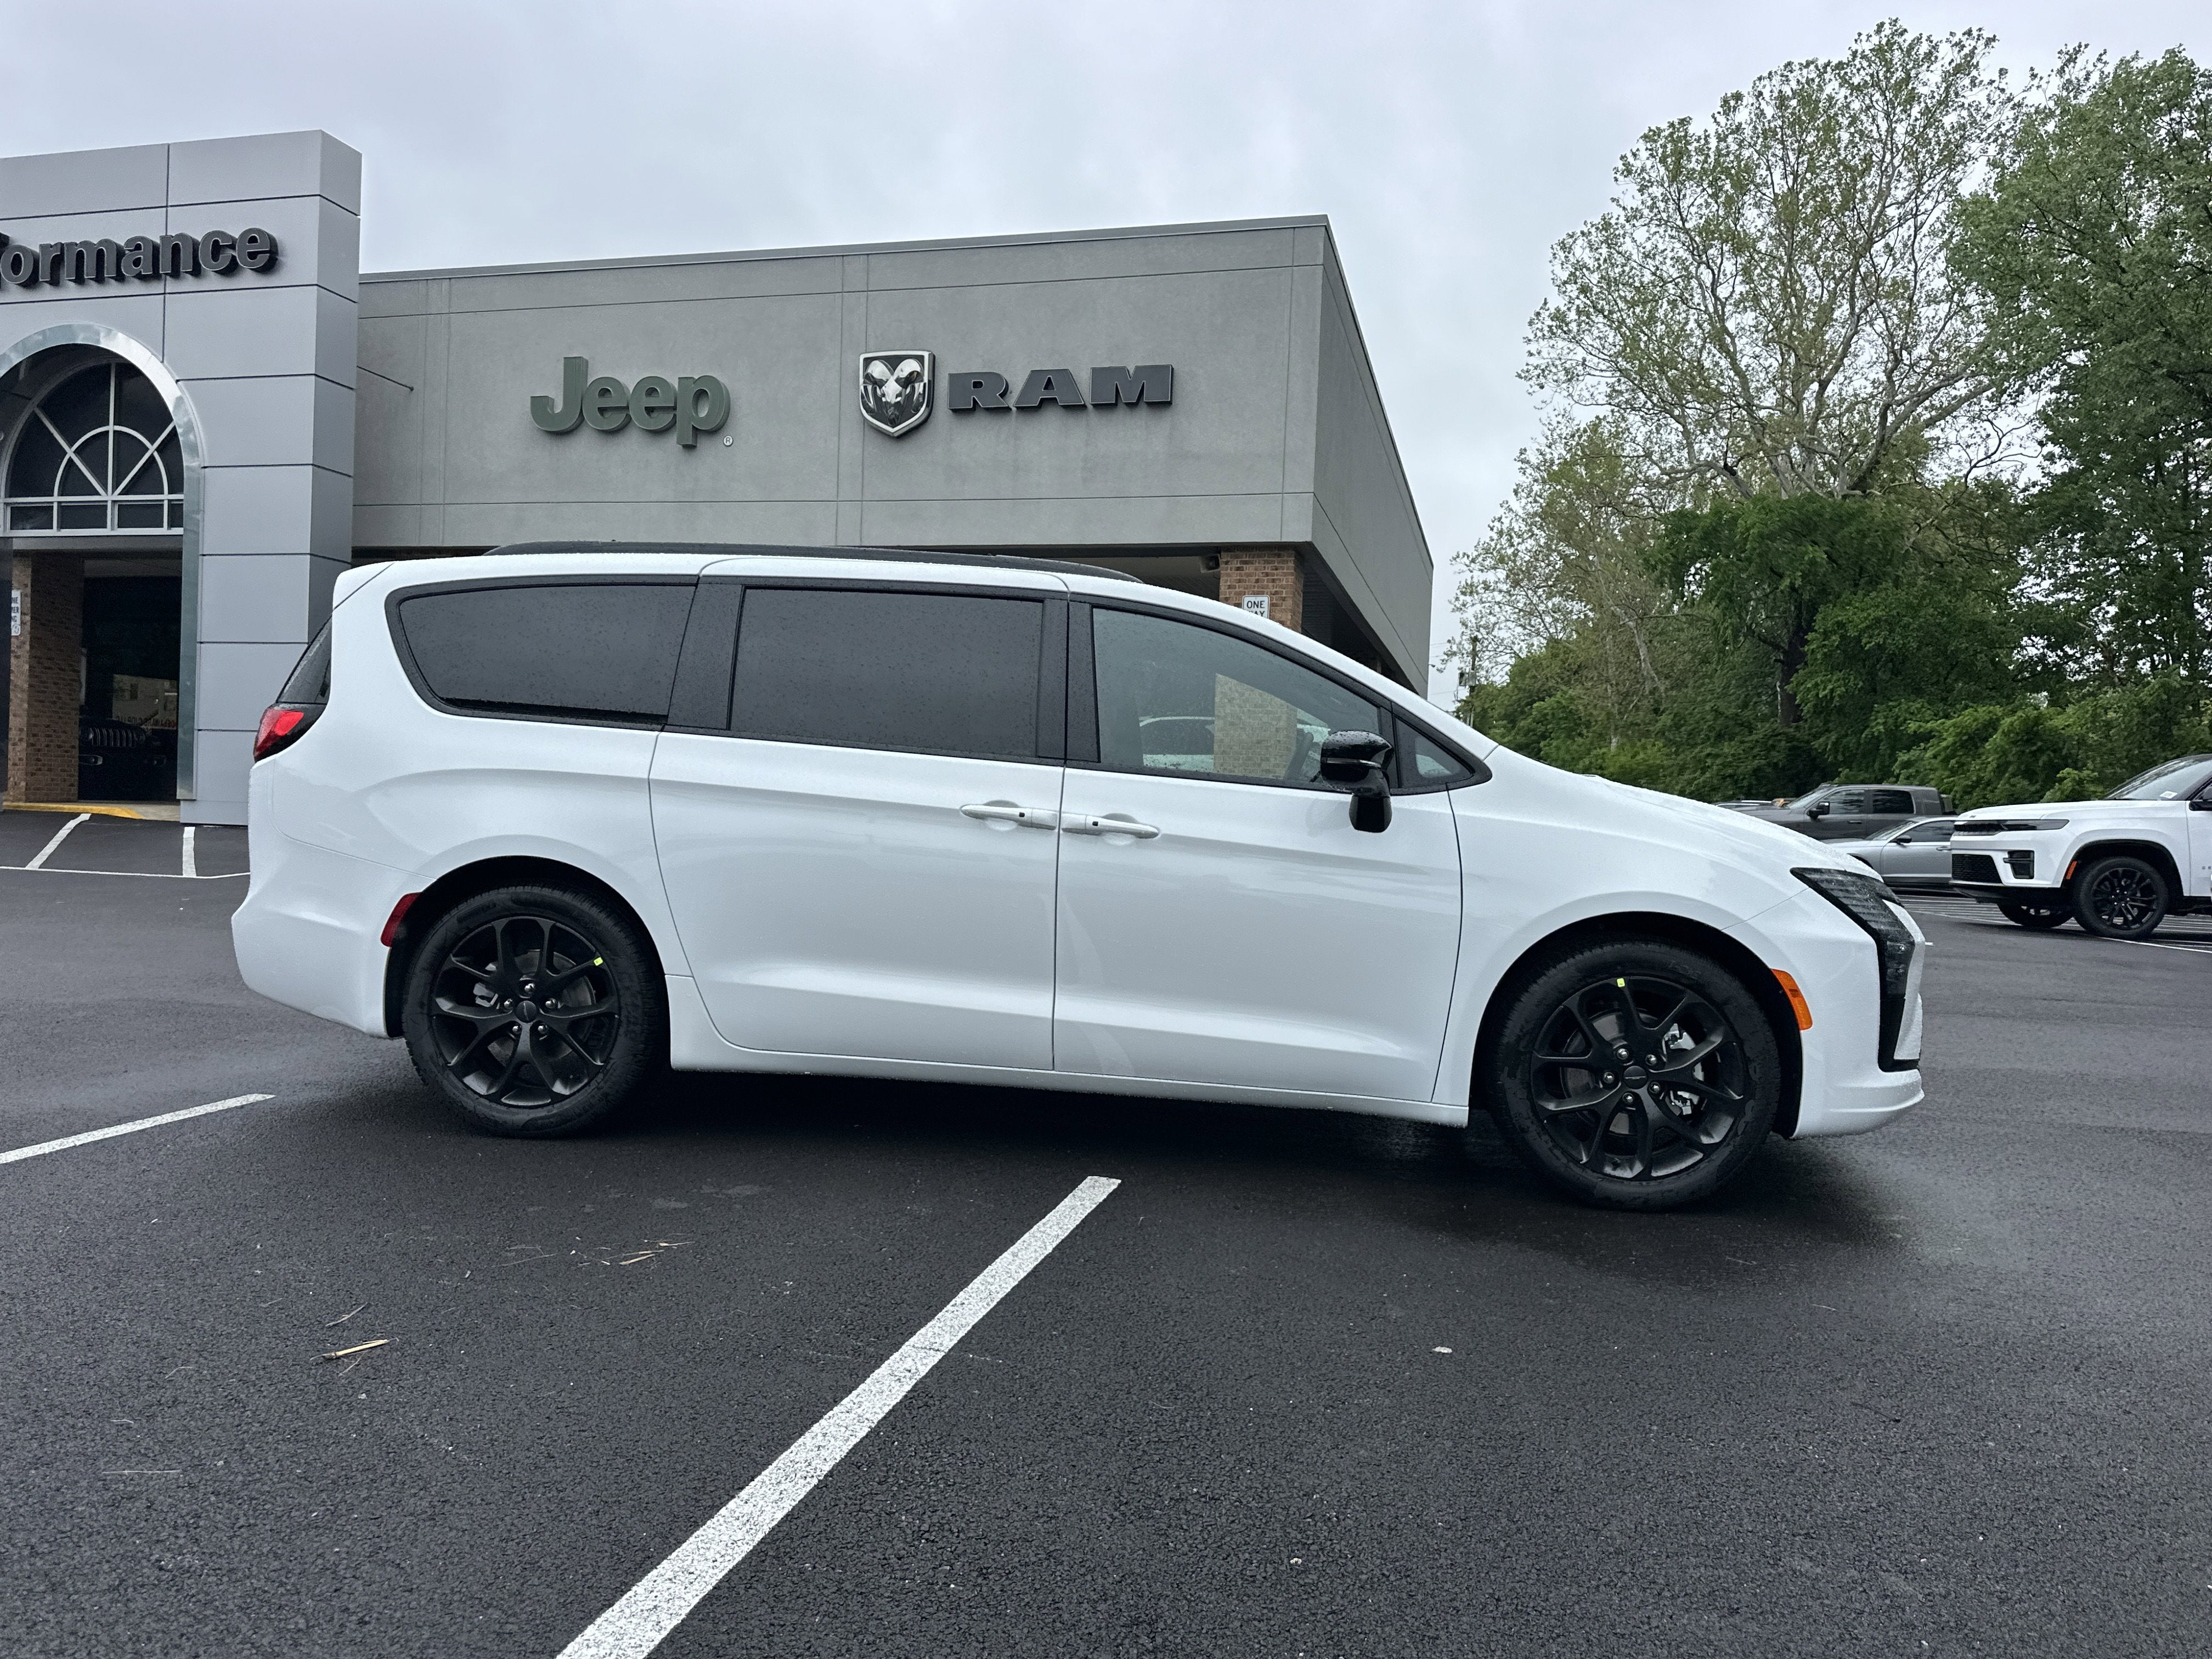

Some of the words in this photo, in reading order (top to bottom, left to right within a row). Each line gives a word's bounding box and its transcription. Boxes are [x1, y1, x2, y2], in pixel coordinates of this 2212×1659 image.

[0, 227, 278, 286] ormance
[530, 356, 730, 448] Jeep
[947, 364, 1173, 411] RAM
